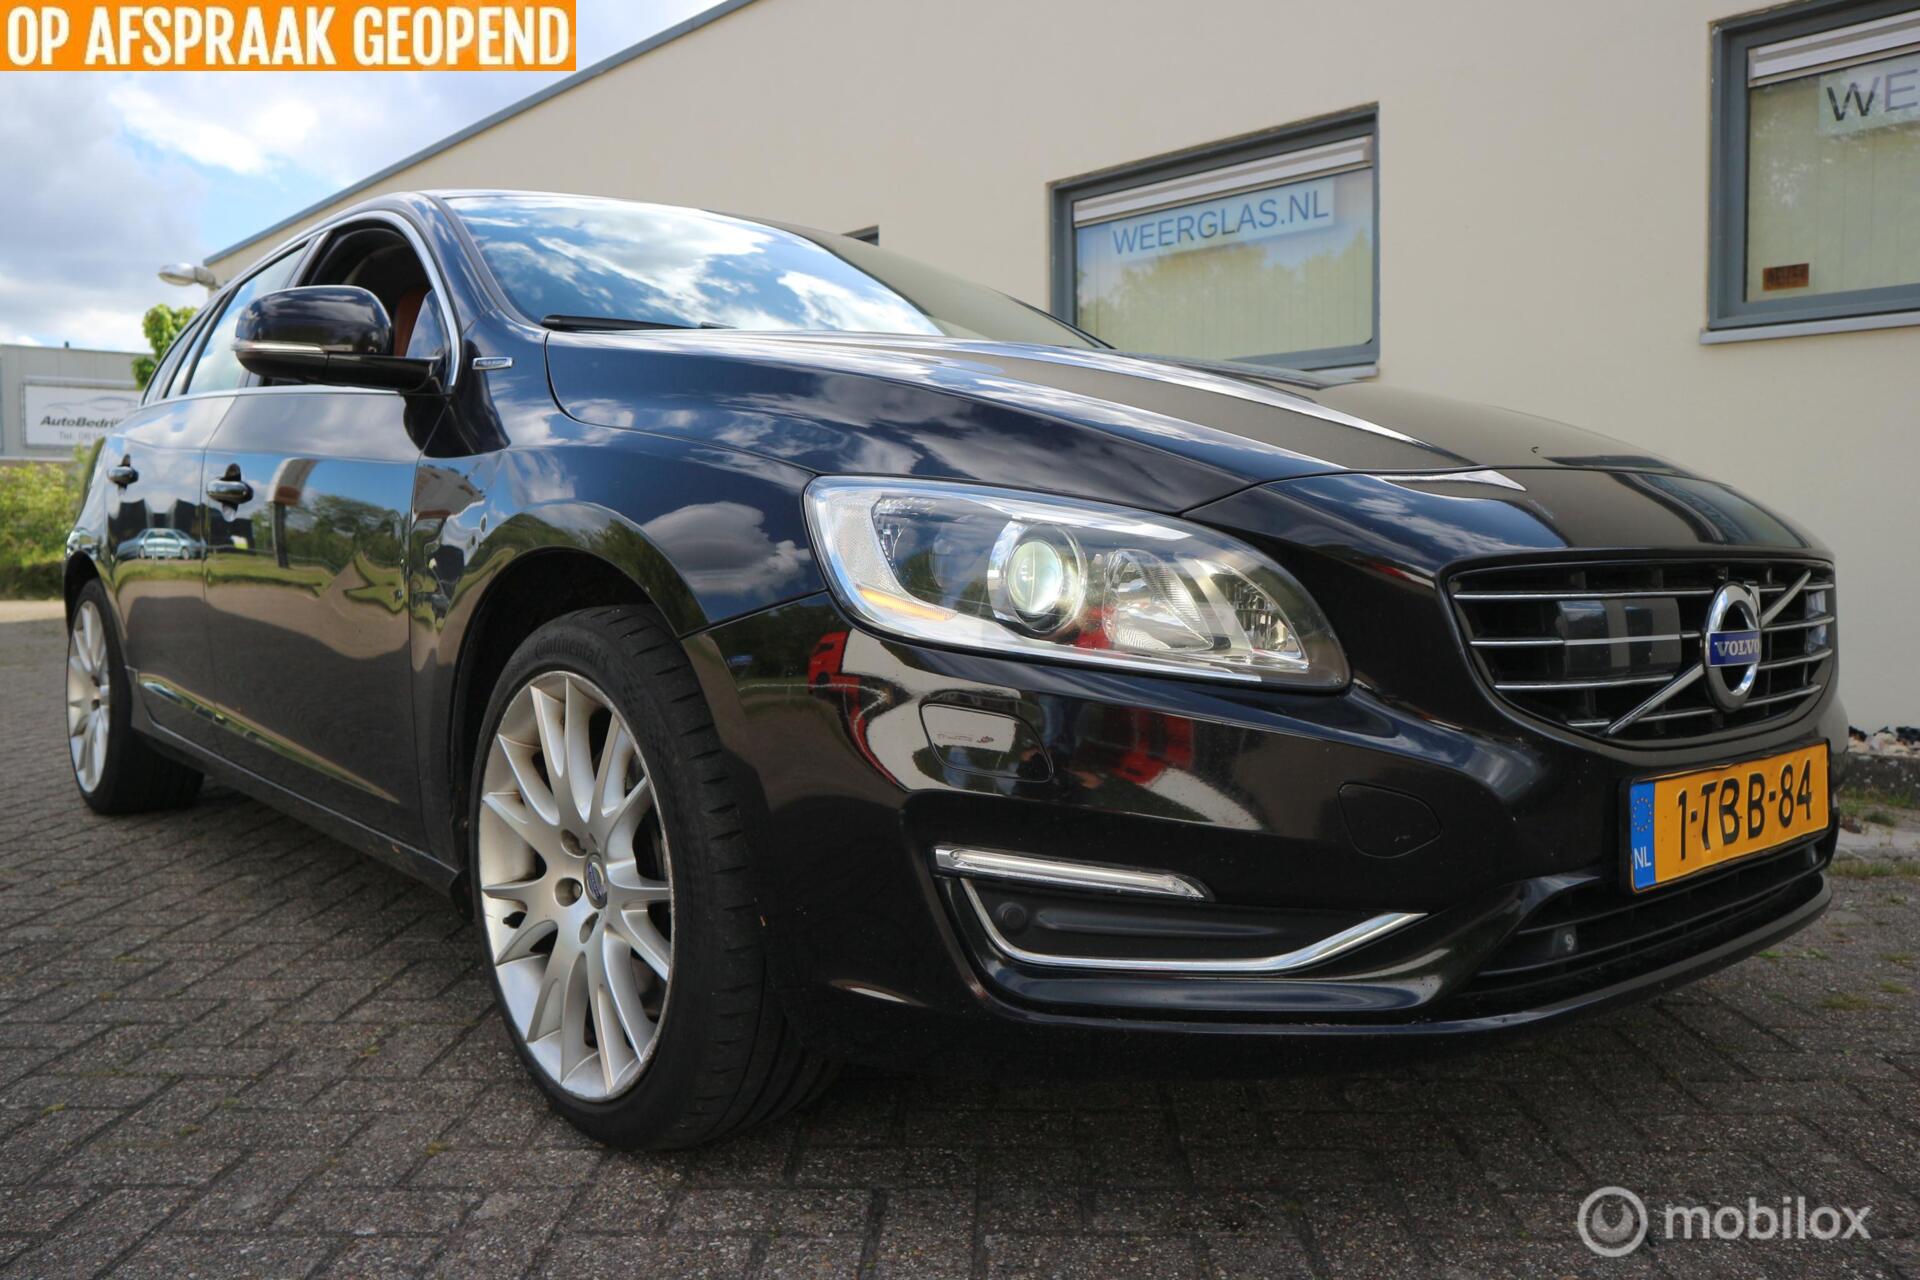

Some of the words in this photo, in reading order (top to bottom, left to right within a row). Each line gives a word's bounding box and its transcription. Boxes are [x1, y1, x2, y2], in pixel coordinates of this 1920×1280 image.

[1112, 189, 1330, 255] WEERGLAS.NL
[1714, 638, 1760, 657] VOLVO
[1676, 759, 1813, 862] 1-TBB-84
[1633, 846, 1652, 871] NL
